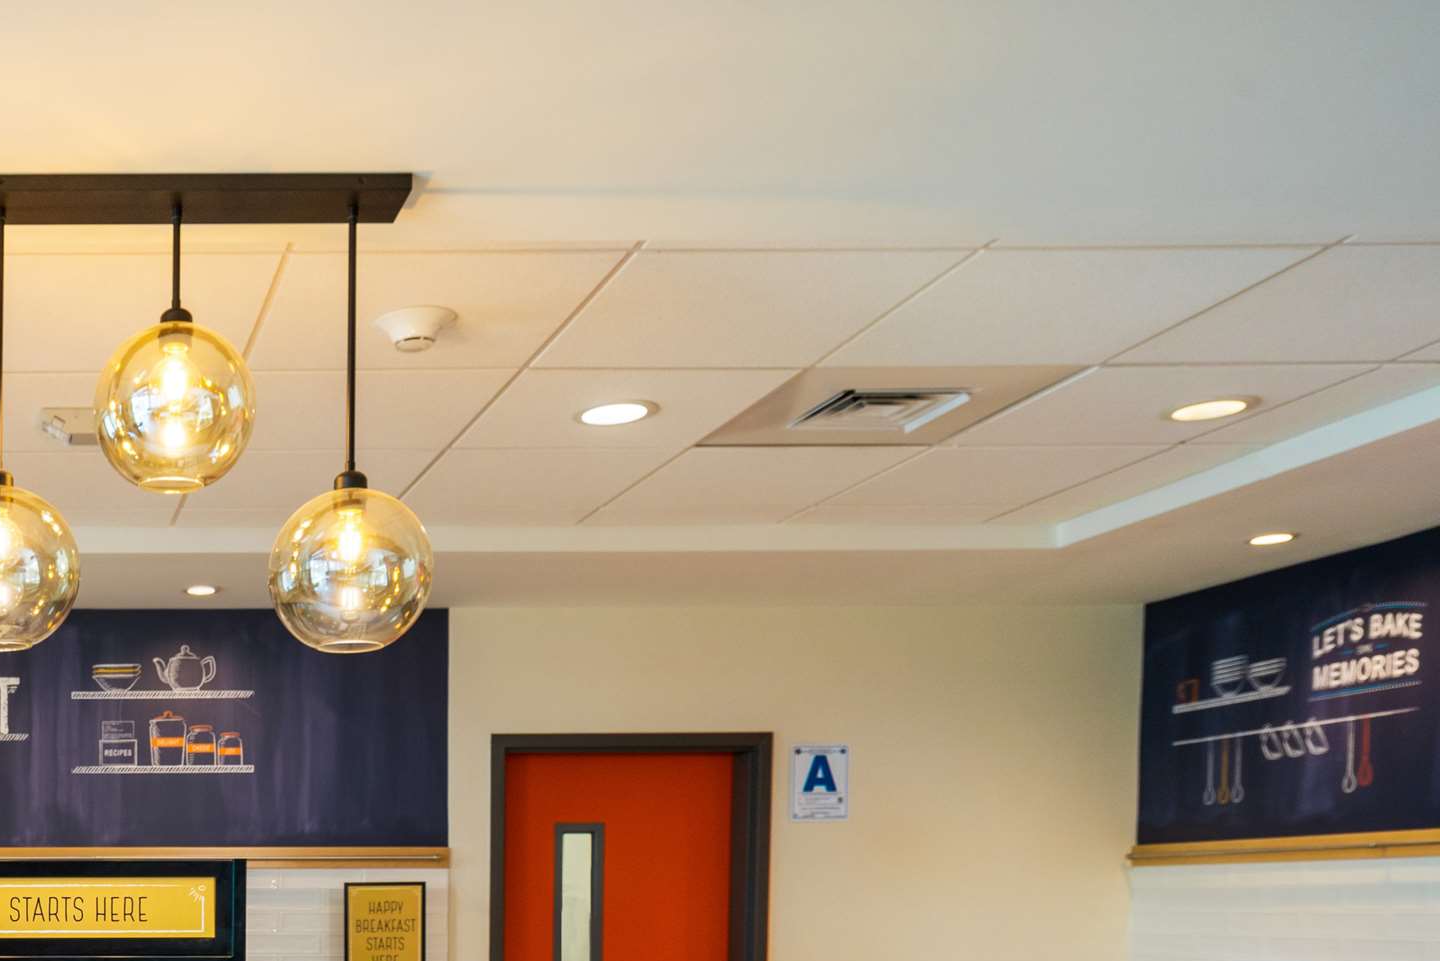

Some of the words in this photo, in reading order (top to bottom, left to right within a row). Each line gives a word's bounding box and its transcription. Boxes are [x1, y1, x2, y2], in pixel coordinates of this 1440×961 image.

[1311, 616, 1365, 659] LET'S
[1368, 611, 1424, 640] BAKE
[1311, 648, 1421, 691] MEMORIES
[104, 748, 133, 757] RECIPES
[802, 754, 838, 793] A
[9, 896, 85, 923] STARTS
[94, 896, 149, 923] HERE
[368, 900, 404, 914] HAPPY
[355, 918, 416, 934] BREAKFAST
[366, 936, 405, 951] STARTS
